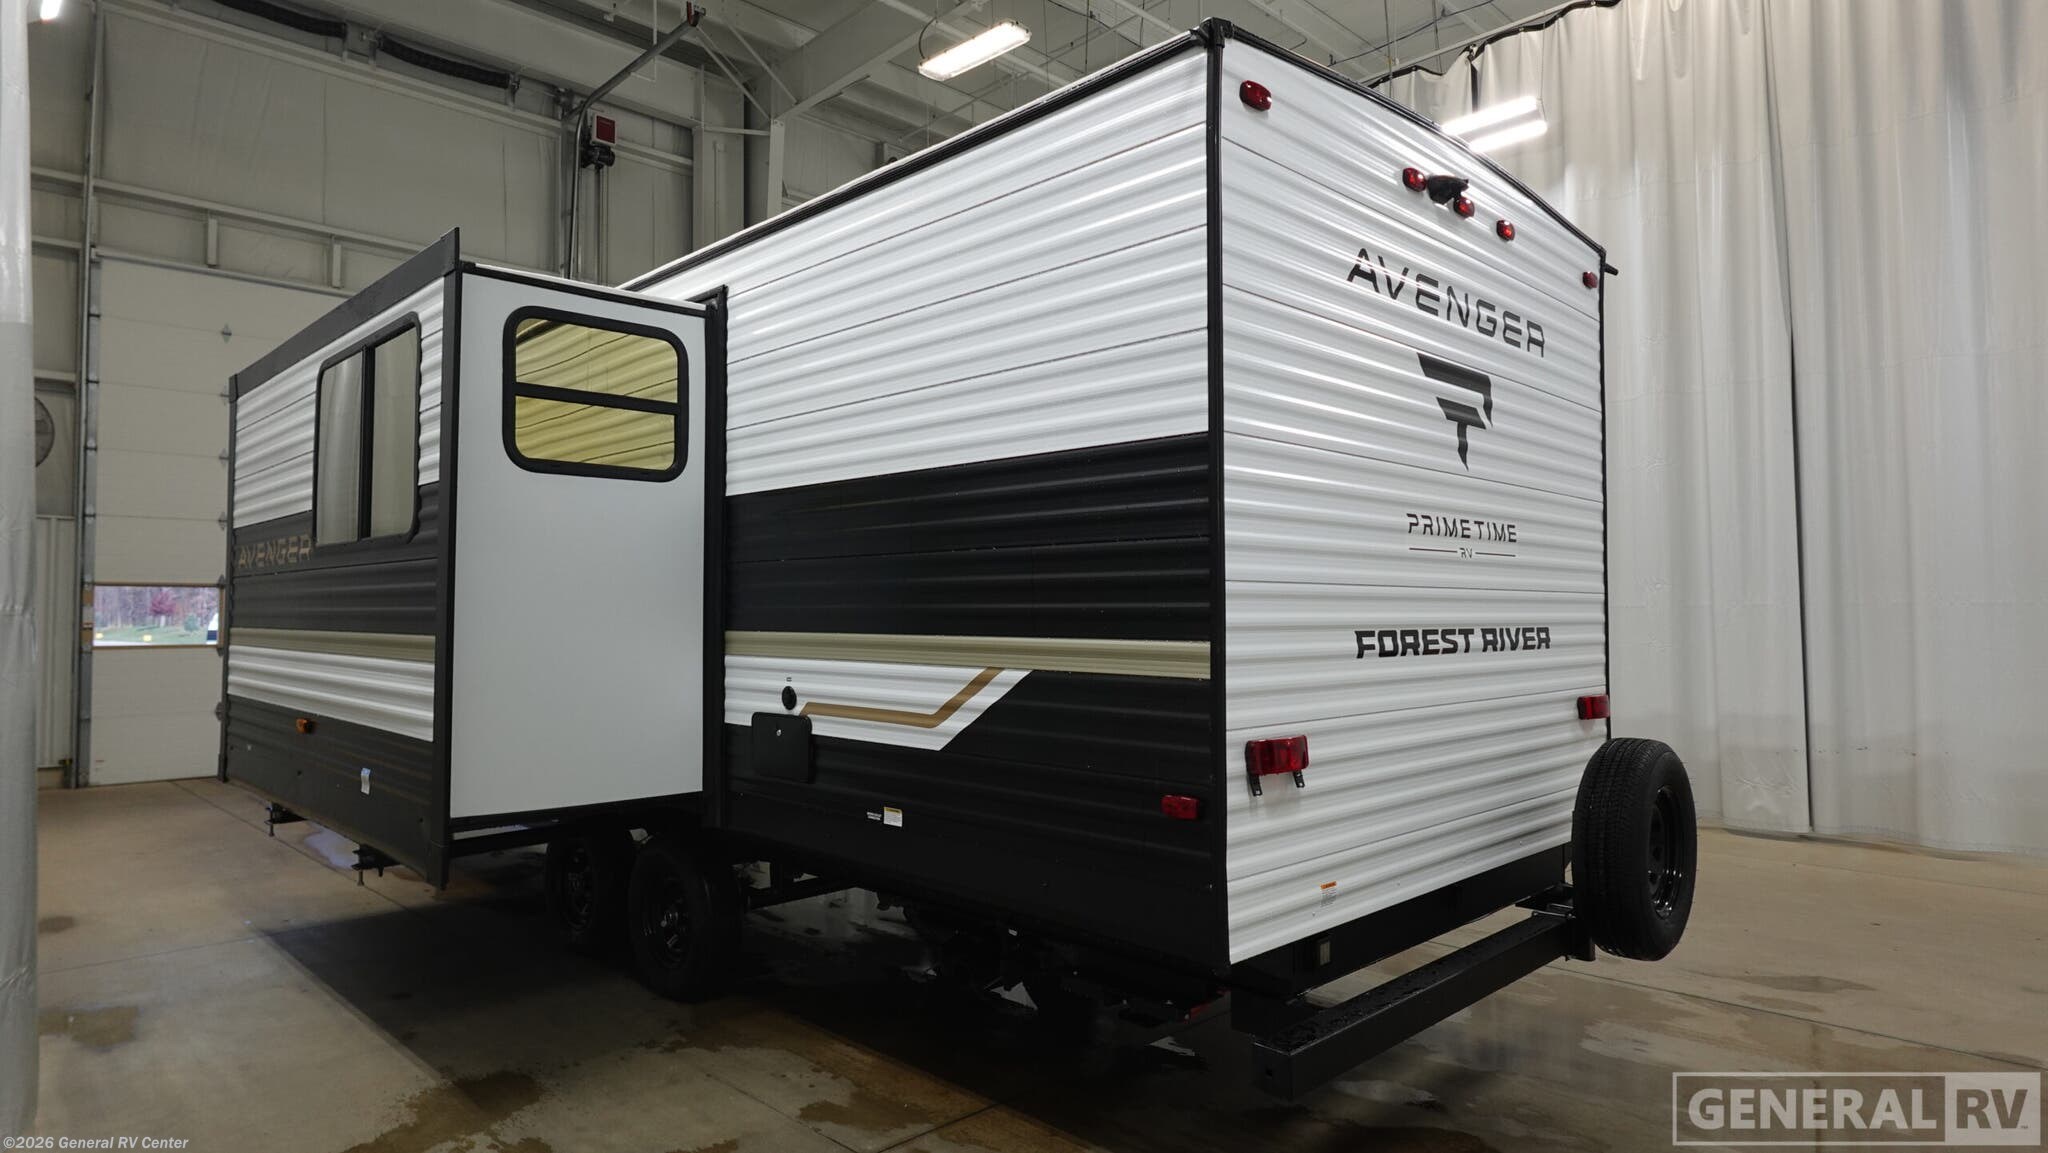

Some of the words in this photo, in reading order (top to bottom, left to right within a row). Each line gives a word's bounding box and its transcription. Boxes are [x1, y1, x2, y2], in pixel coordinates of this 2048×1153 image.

[1346, 247, 1545, 358] AVENGER
[1406, 513, 1517, 543] PRIMETIME
[238, 534, 312, 569] AVENGER
[1459, 547, 1473, 559] RV
[1354, 628, 1475, 659] FOREST
[1480, 626, 1551, 653] RIVER
